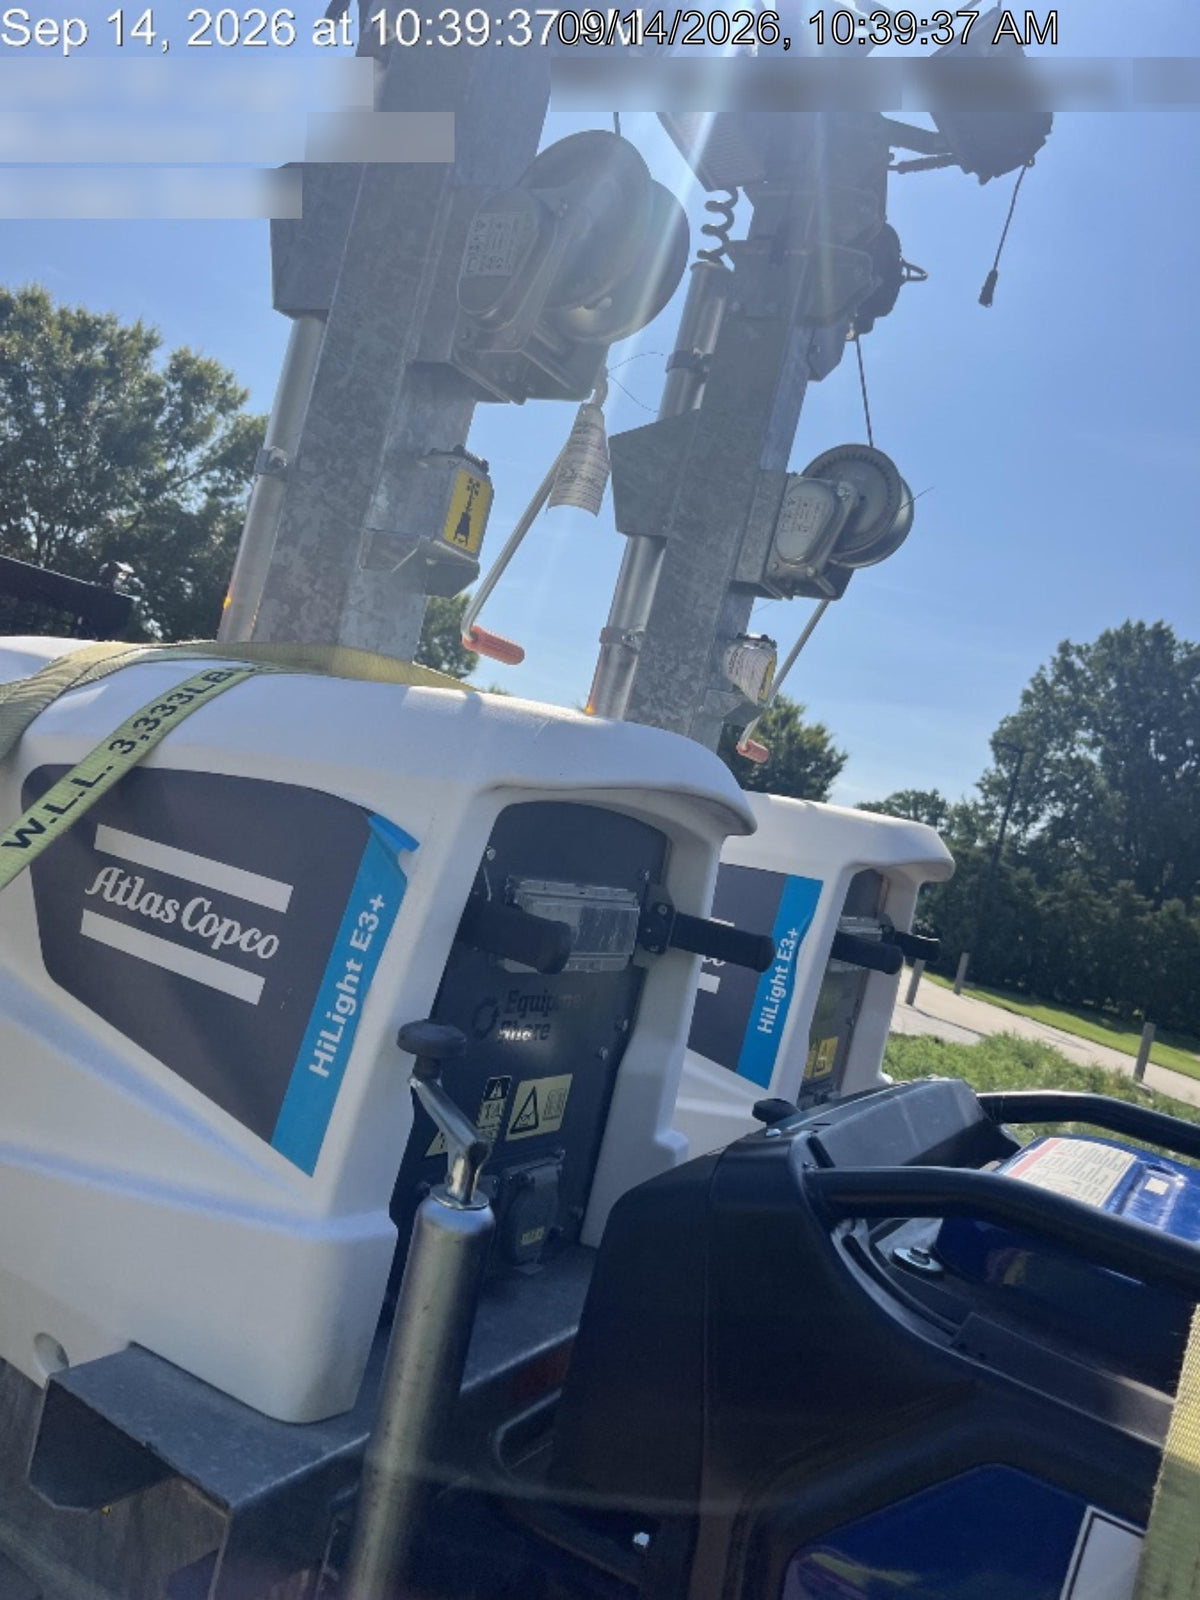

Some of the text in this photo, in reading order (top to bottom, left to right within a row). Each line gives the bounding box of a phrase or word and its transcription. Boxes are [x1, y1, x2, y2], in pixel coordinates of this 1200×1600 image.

[1, 765, 115, 849] W.L.L.
[84, 866, 280, 959] Atlas Copco
[308, 894, 387, 1078] HiLight E3+
[757, 927, 799, 1034] HiLight E3+
